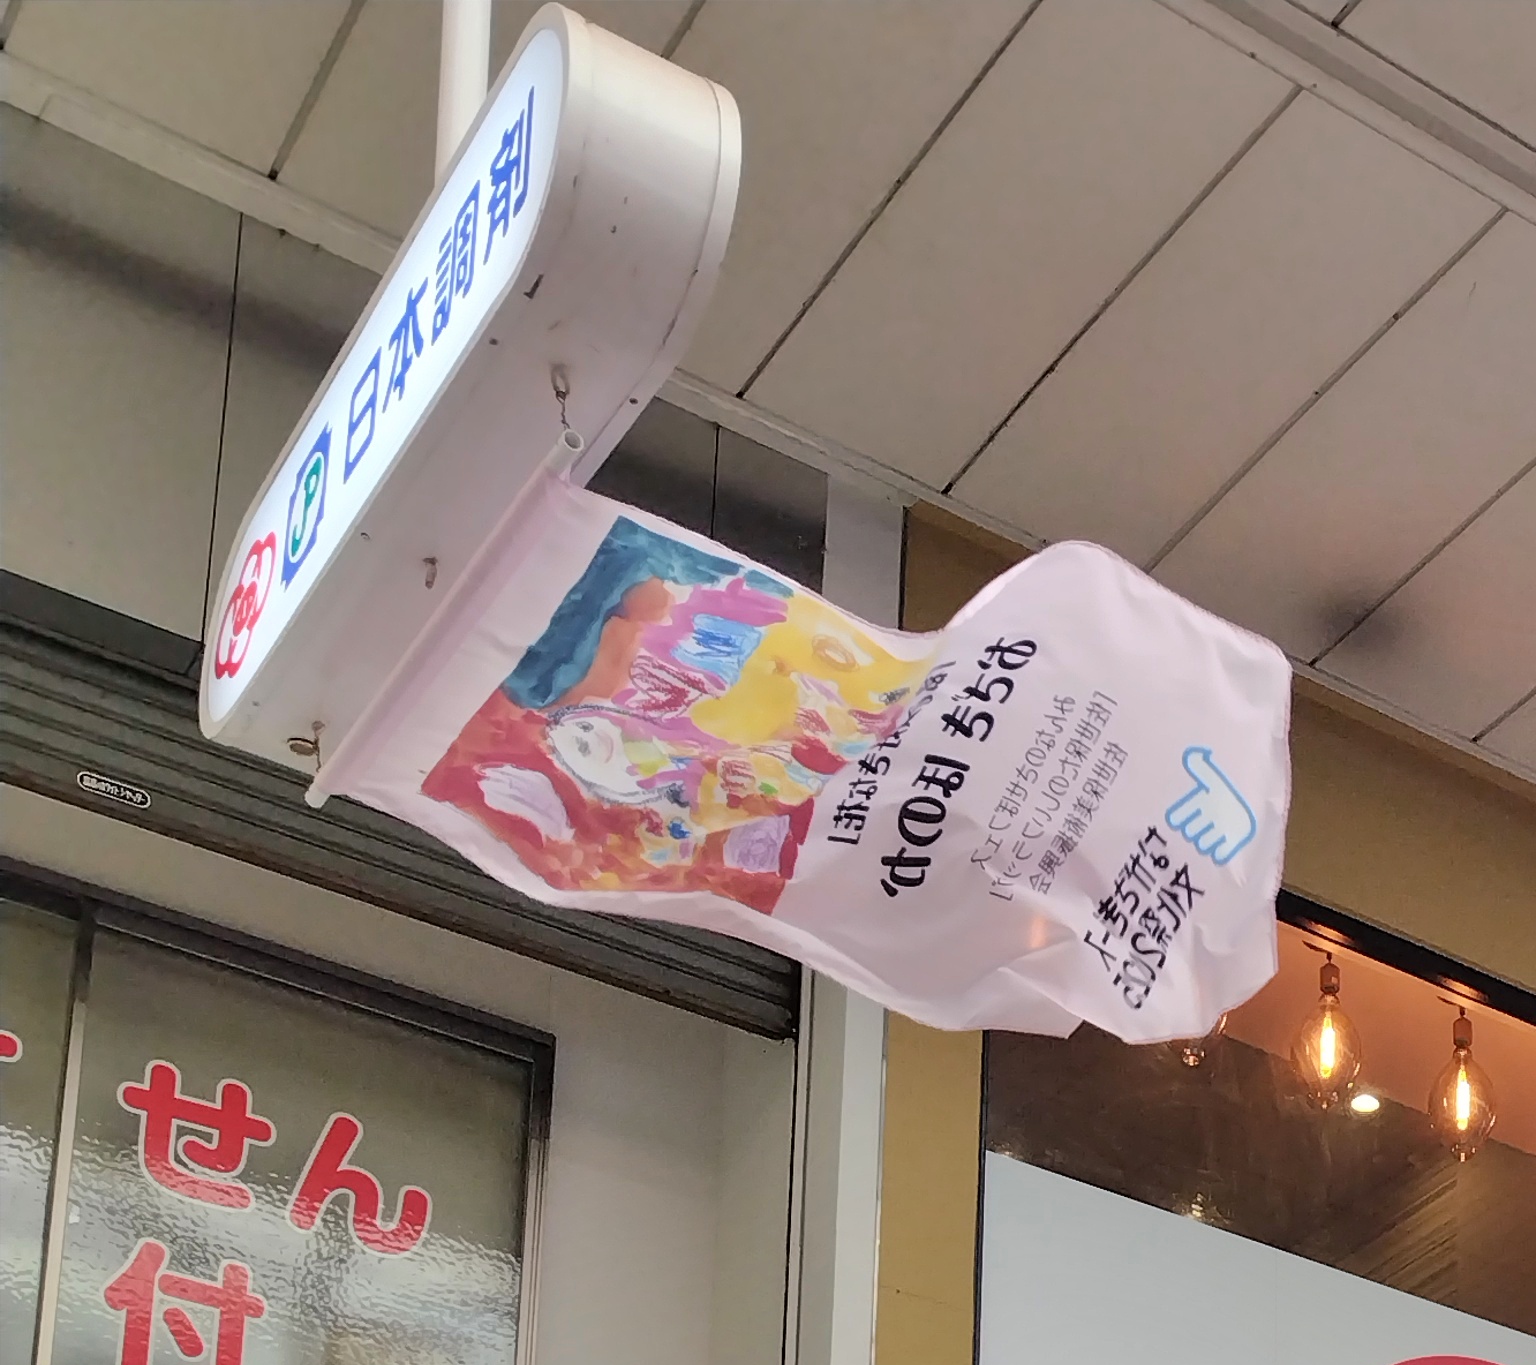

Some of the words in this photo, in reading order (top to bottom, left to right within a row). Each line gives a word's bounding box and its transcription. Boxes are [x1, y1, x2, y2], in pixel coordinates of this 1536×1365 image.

[343, 86, 536, 486] 日本調剤
[0, 1030, 432, 1255] せん
